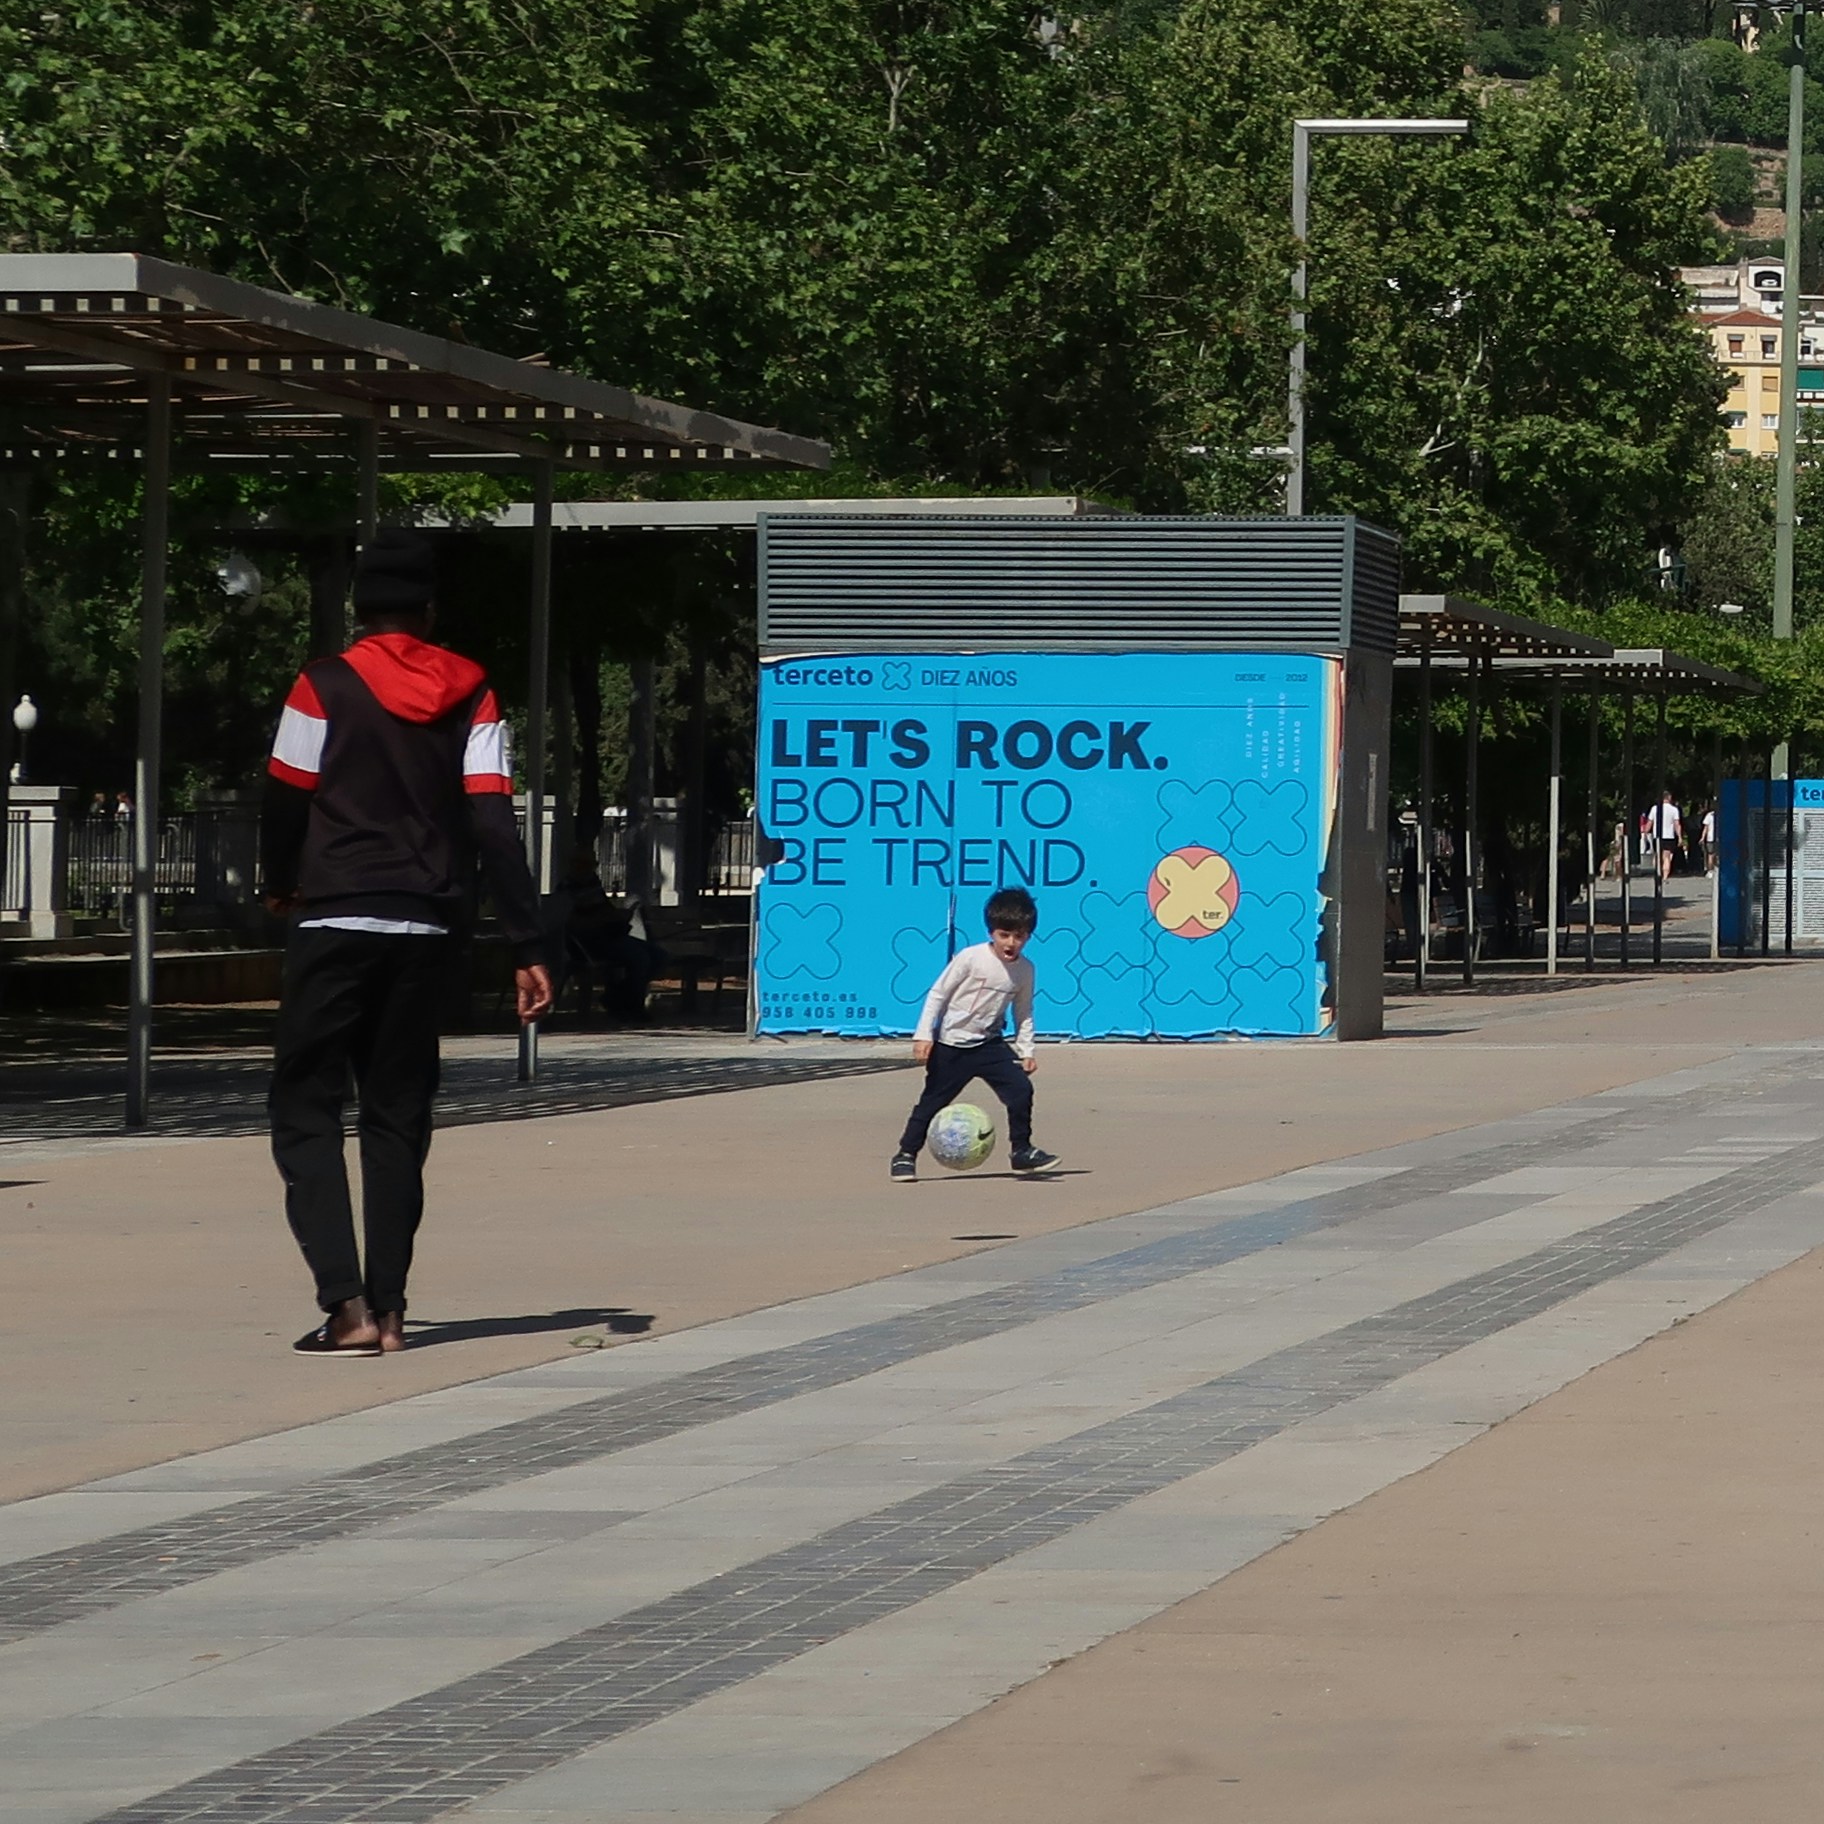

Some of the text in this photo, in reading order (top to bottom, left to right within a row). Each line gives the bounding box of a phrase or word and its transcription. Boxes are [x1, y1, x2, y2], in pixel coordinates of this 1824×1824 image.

[772, 665, 1018, 687] terceto DIEZ AÑOS
[1235, 673, 1266, 682] DESDE
[771, 719, 1168, 770] LET'S ROCK.
[1261, 730, 1269, 778] CALIDAD
[1293, 720, 1301, 773] AGILIDAD
[769, 777, 1072, 829] BORN TO
[768, 837, 1099, 888] BE TREND.
[1202, 910, 1224, 920] ter.
[762, 991, 858, 1002] terceto.es
[762, 1006, 794, 1019] 958
[803, 1006, 835, 1019] 405
